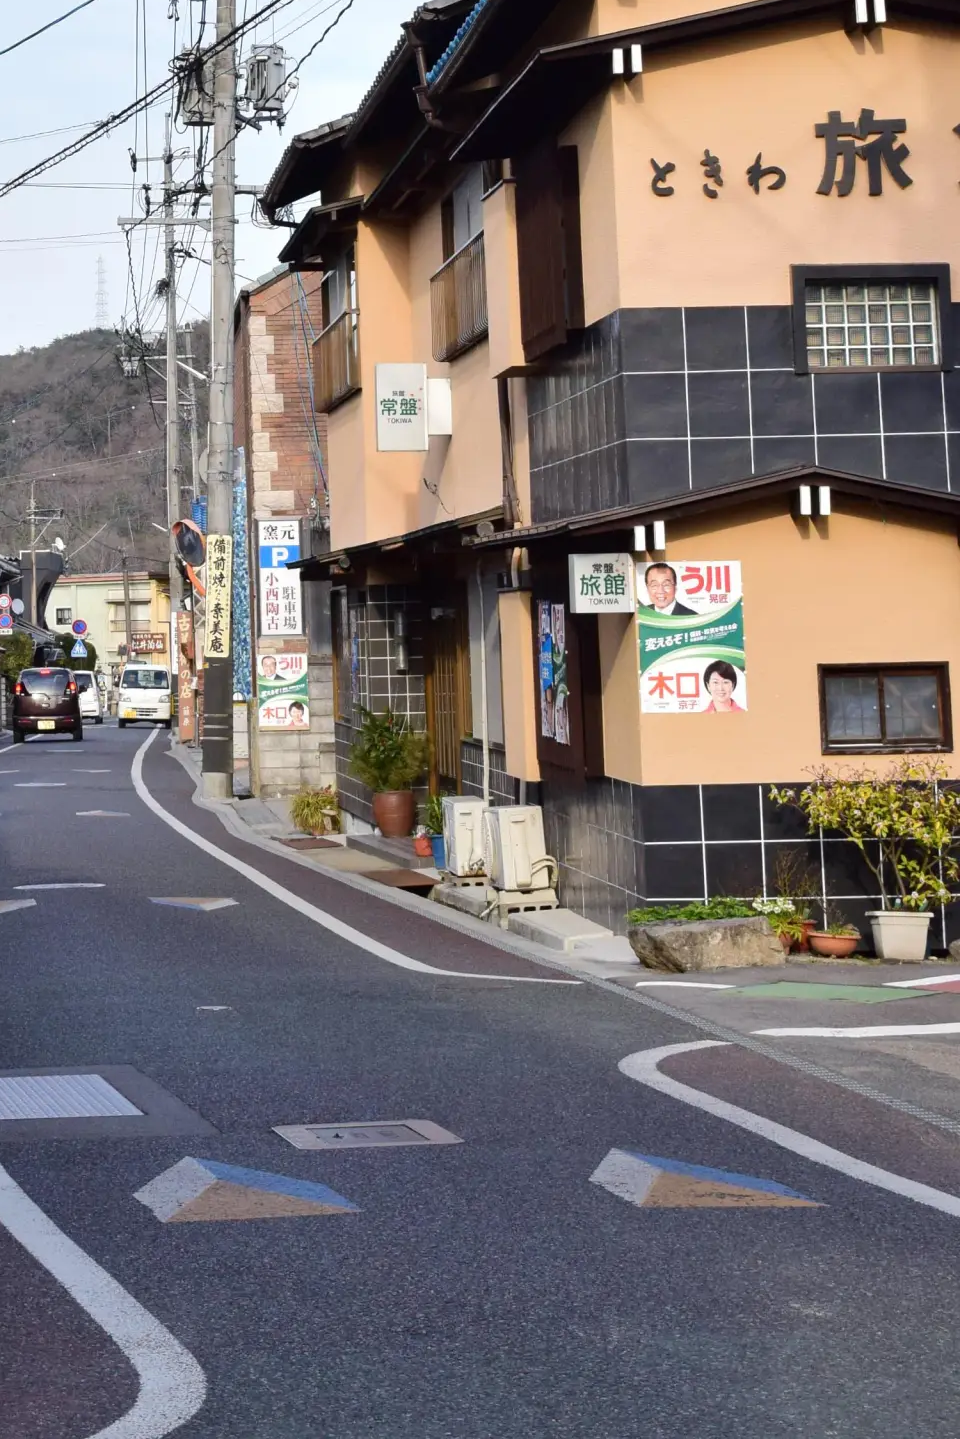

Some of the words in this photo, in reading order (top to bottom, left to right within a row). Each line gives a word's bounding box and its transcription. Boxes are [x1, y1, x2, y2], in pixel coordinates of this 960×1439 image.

[814, 108, 960, 198] 旅
[649, 149, 786, 199] ときわ
[380, 398, 418, 416] 常盤
[263, 525, 295, 540] 窯元
[271, 547, 289, 567] P
[592, 563, 614, 574] 常盤
[580, 574, 625, 596] 旅館
[680, 565, 731, 595] う川
[265, 572, 280, 631] 小西陶古
[282, 586, 298, 630] 駐車場
[588, 598, 620, 606] TOKIWA
[648, 672, 700, 699] 木口
[263, 707, 287, 719] 木口
